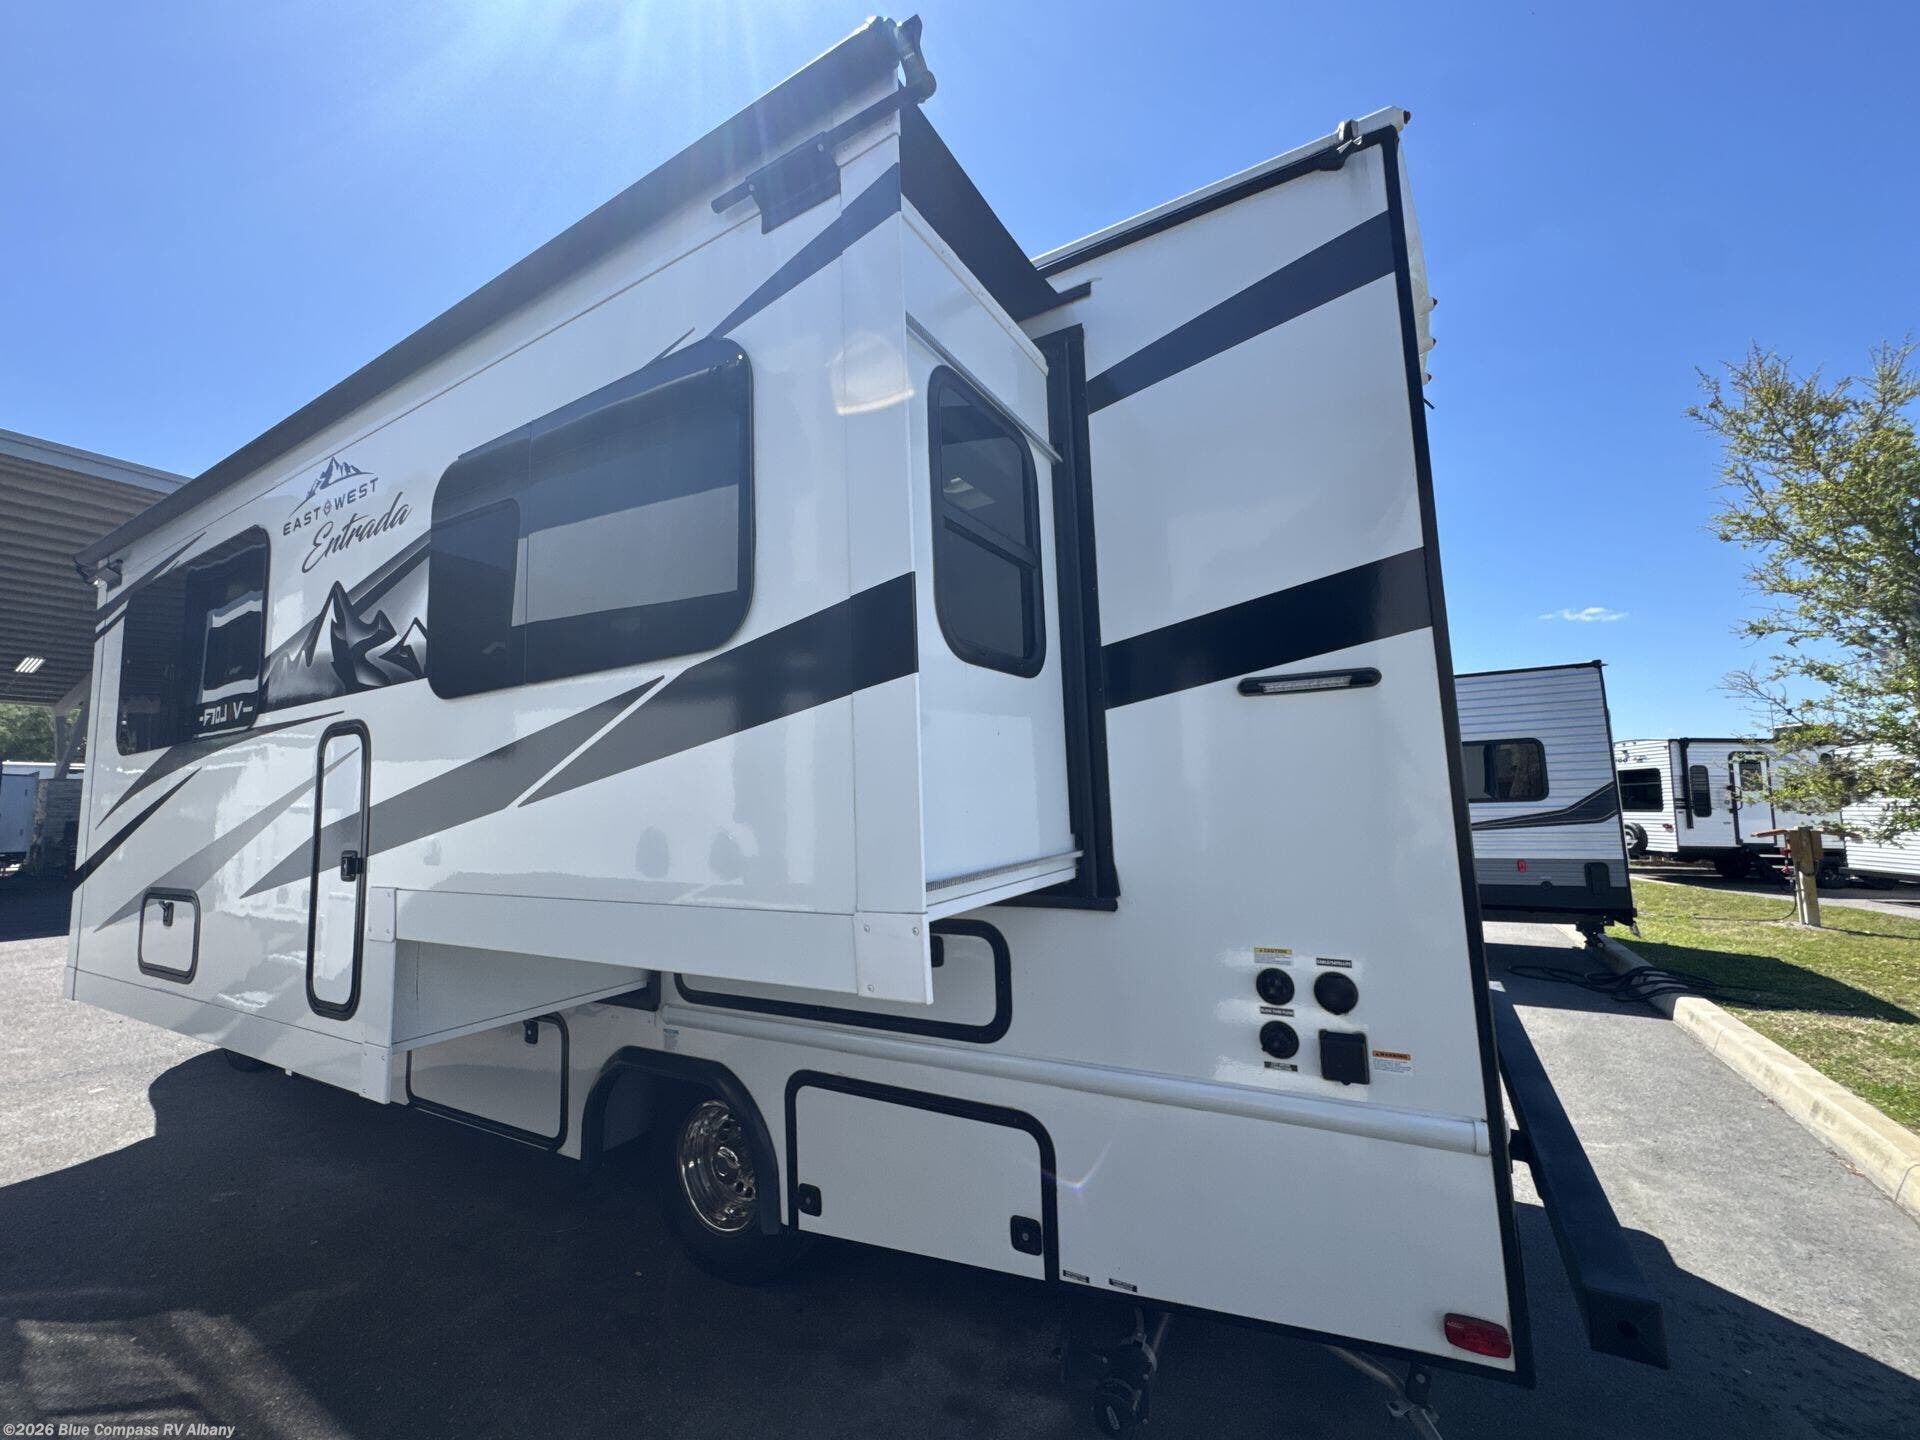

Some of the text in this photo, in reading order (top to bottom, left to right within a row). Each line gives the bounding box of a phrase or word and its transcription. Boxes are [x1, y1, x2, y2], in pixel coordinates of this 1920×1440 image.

[283, 506, 321, 536] EAST
[334, 477, 379, 510] WEST
[301, 491, 413, 573] Entrada
